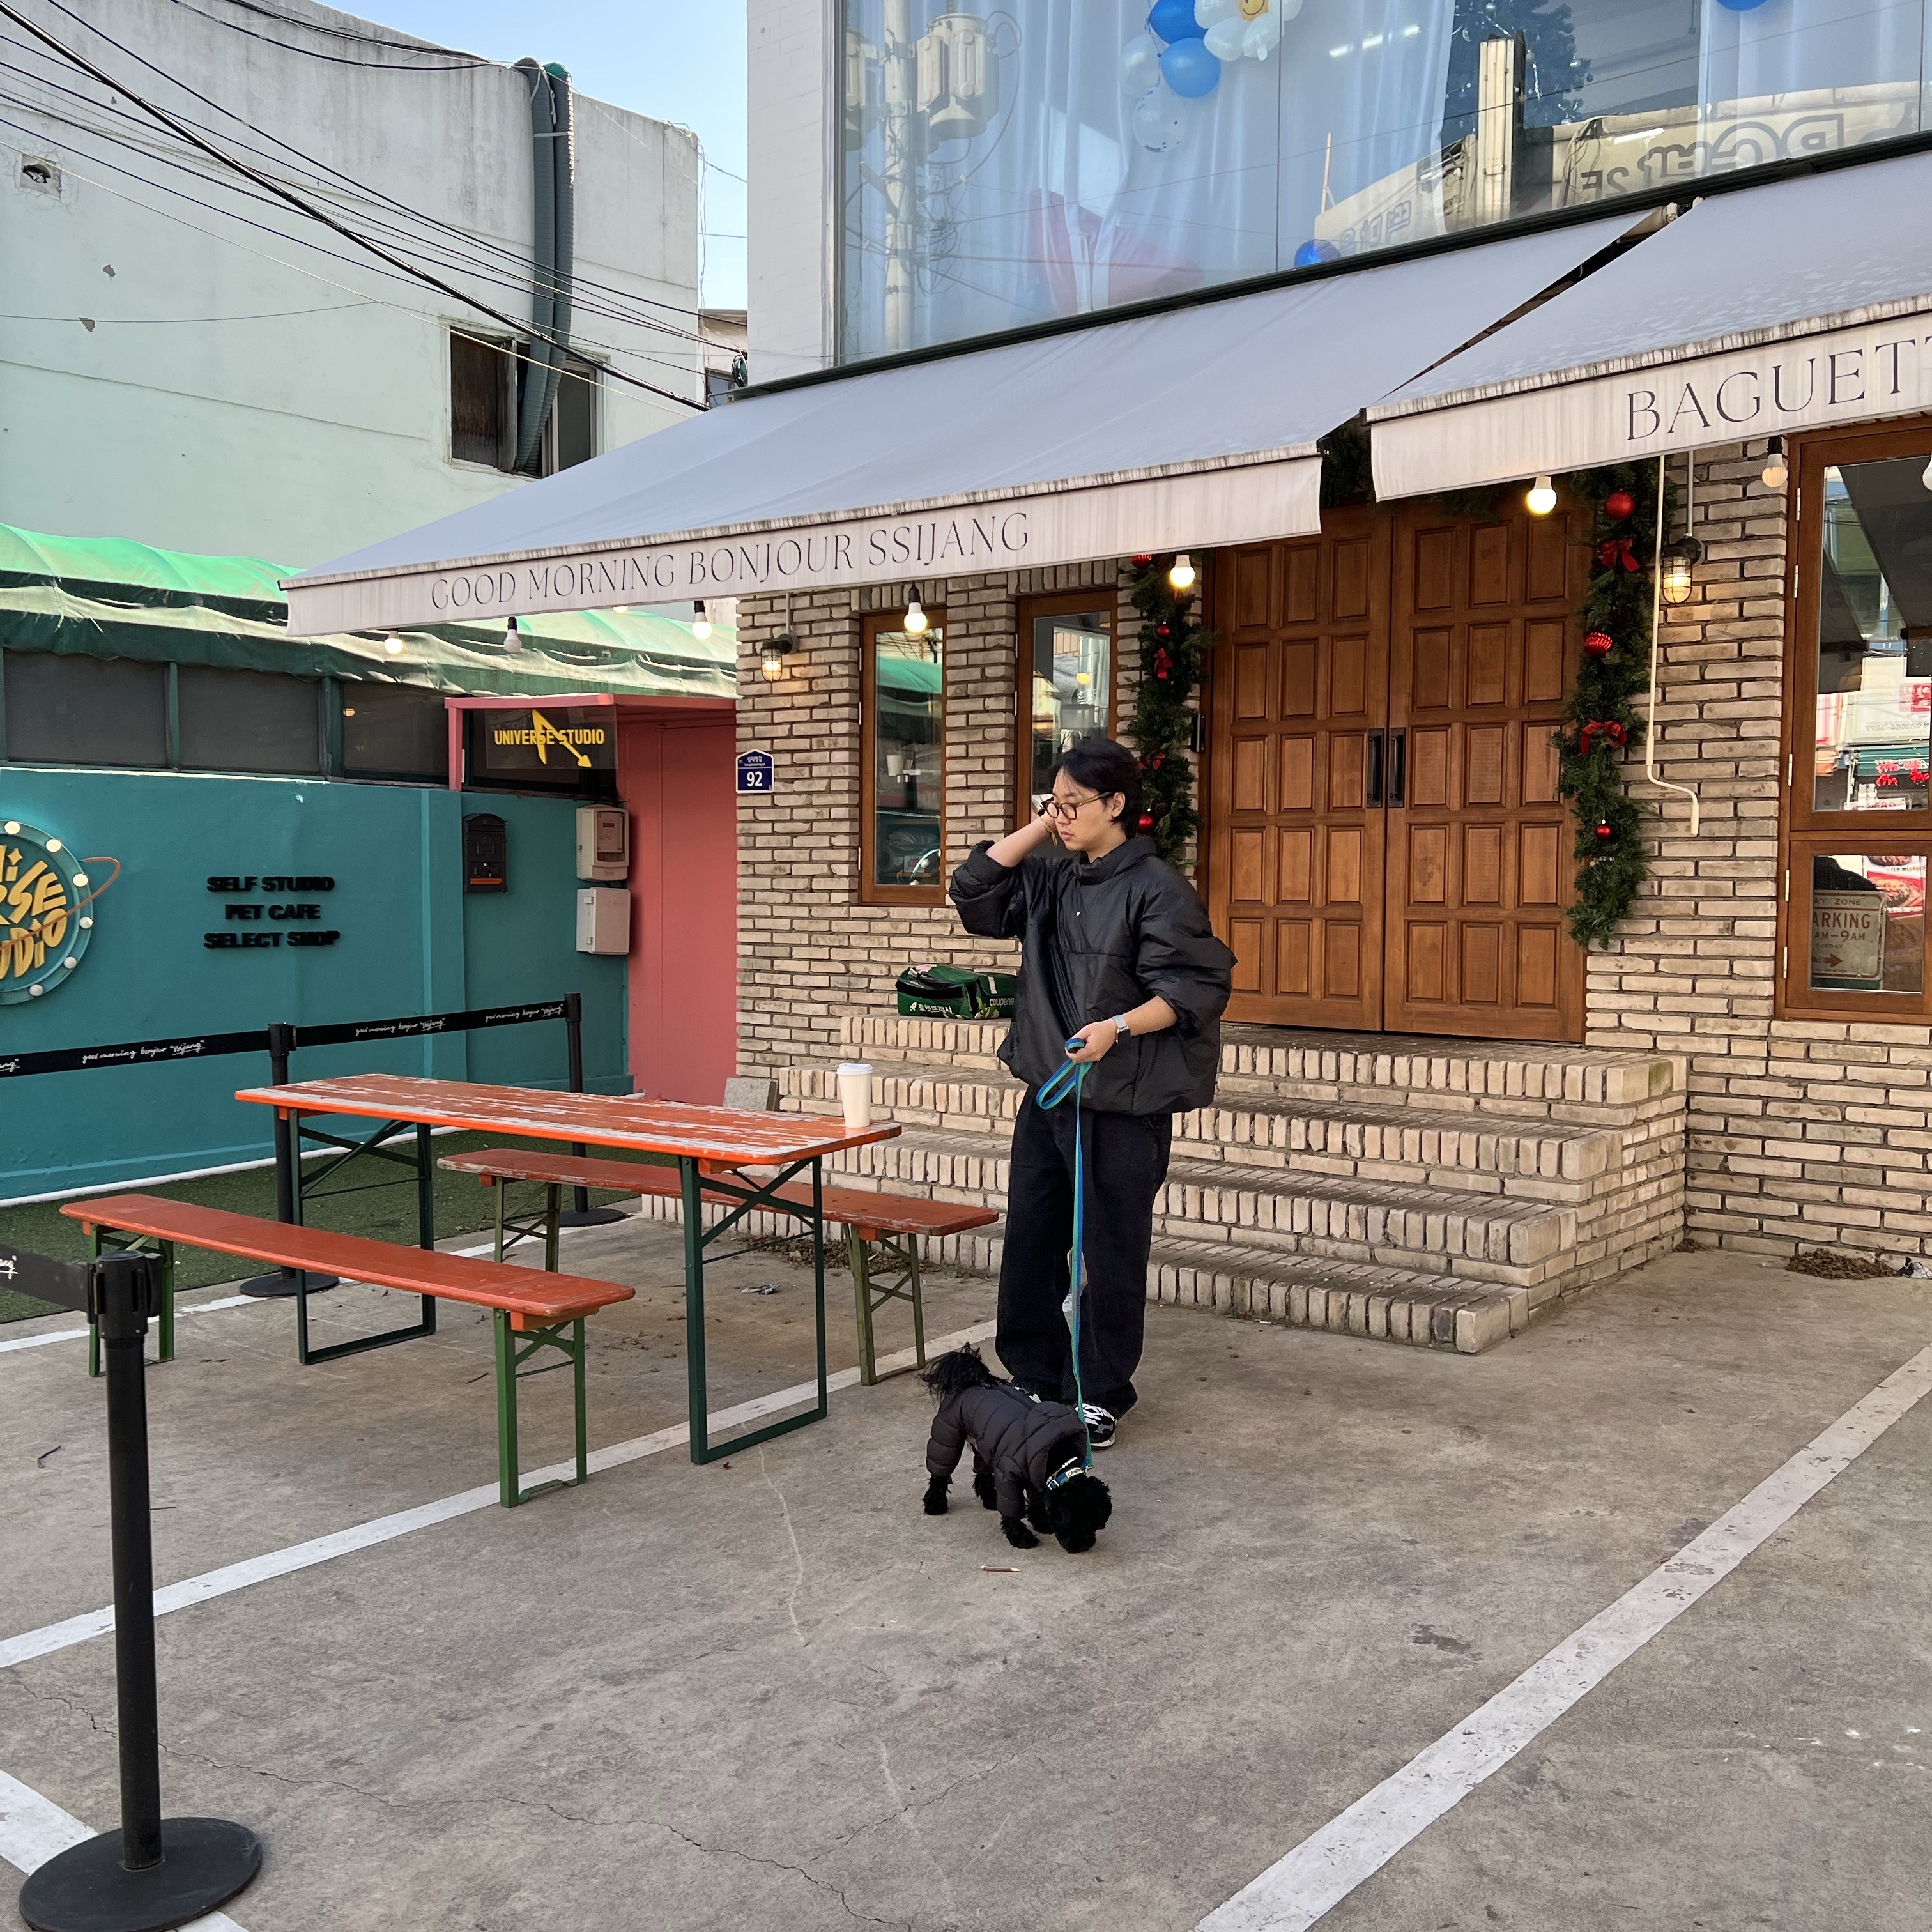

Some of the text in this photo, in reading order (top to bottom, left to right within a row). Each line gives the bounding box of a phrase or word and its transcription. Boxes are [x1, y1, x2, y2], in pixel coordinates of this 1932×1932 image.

[1627, 335, 1932, 441] BAGUET
[432, 512, 1028, 610] GOOD MORNING BONJOUR SSIJANG
[494, 728, 605, 746] UNIVERSE STUDIO
[746, 770, 763, 787] 92
[206, 875, 335, 892] SELF STUDIO
[225, 904, 321, 920] PET CAFE
[203, 930, 341, 949] SELECT SHOP
